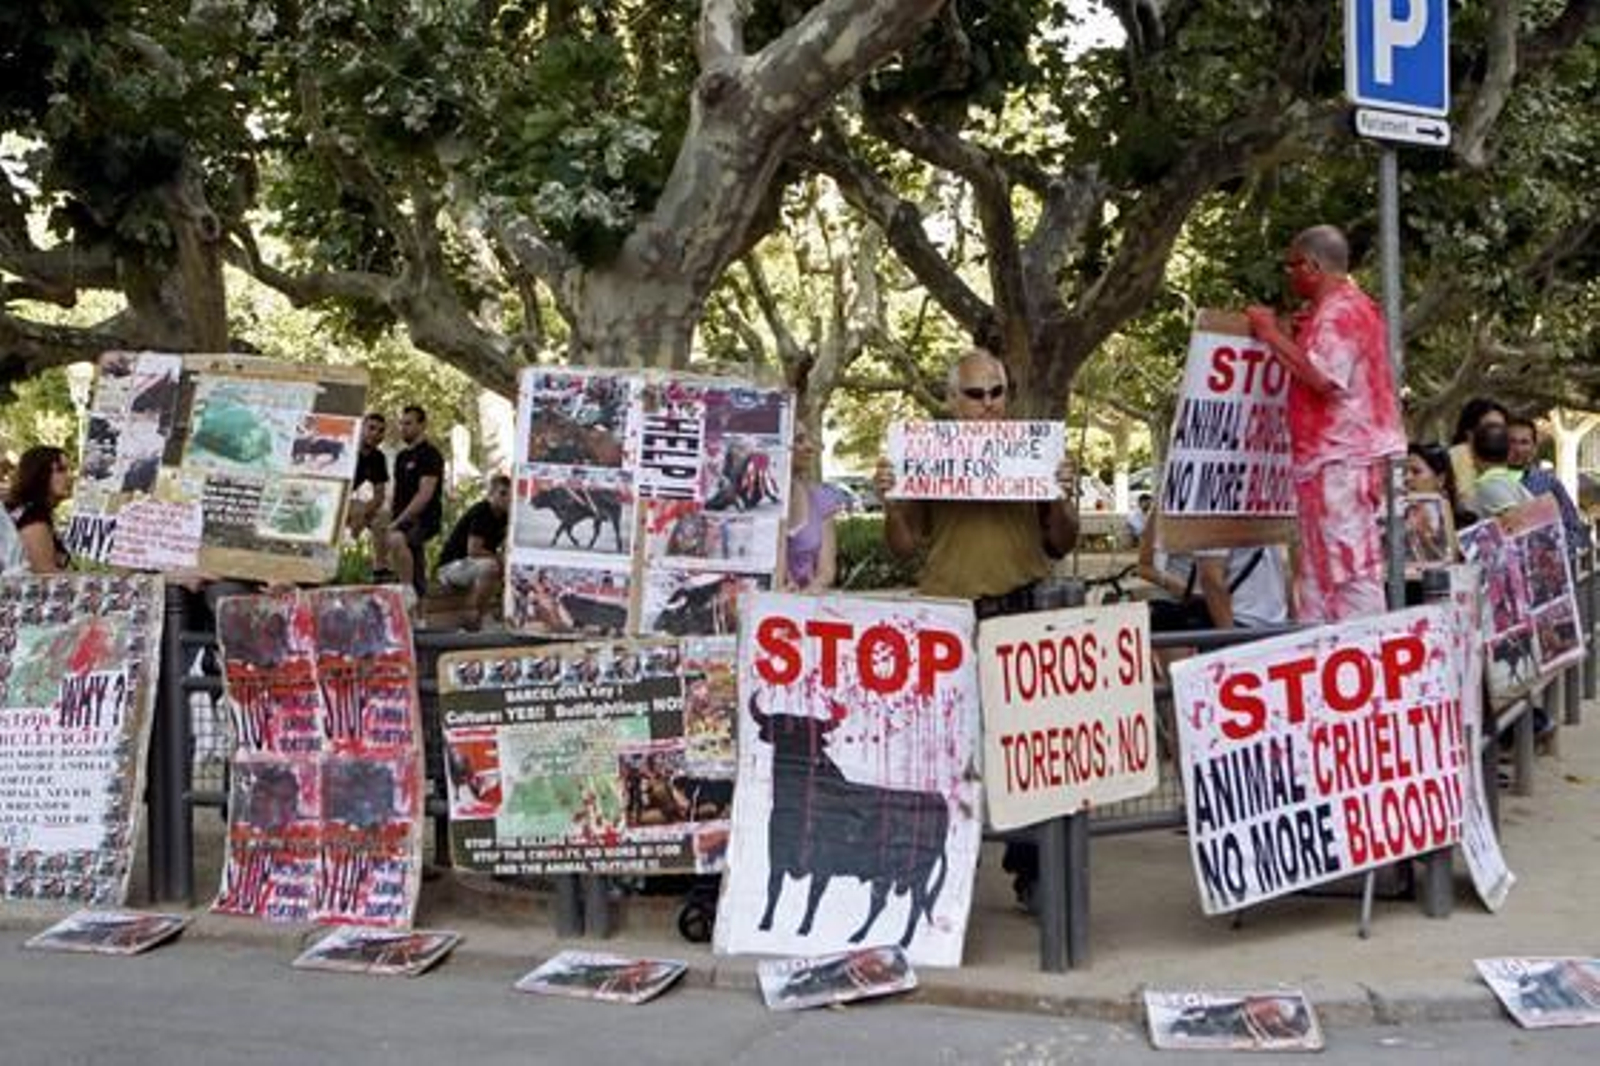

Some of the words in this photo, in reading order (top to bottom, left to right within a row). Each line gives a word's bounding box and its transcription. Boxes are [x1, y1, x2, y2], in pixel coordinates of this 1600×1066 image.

[1372, 0, 1429, 86] P
[1207, 346, 1287, 397] STO
[1174, 399, 1241, 451] ANIMAL
[903, 476, 974, 496] ANIMAL
[982, 476, 1049, 497] RIGHTS
[1162, 462, 1196, 512] NO
[1196, 462, 1247, 512] MORE
[504, 684, 587, 703] BARCELONA
[754, 615, 964, 699] STOP
[995, 633, 1110, 705] TOROS:
[1117, 626, 1144, 687] SI
[1217, 635, 1428, 741] STOP
[1000, 719, 1117, 793] TOREROS:
[1118, 712, 1149, 773] NO
[1193, 733, 1306, 833] ANIMAL
[1196, 831, 1249, 908] NO
[1251, 803, 1341, 895] MORE
